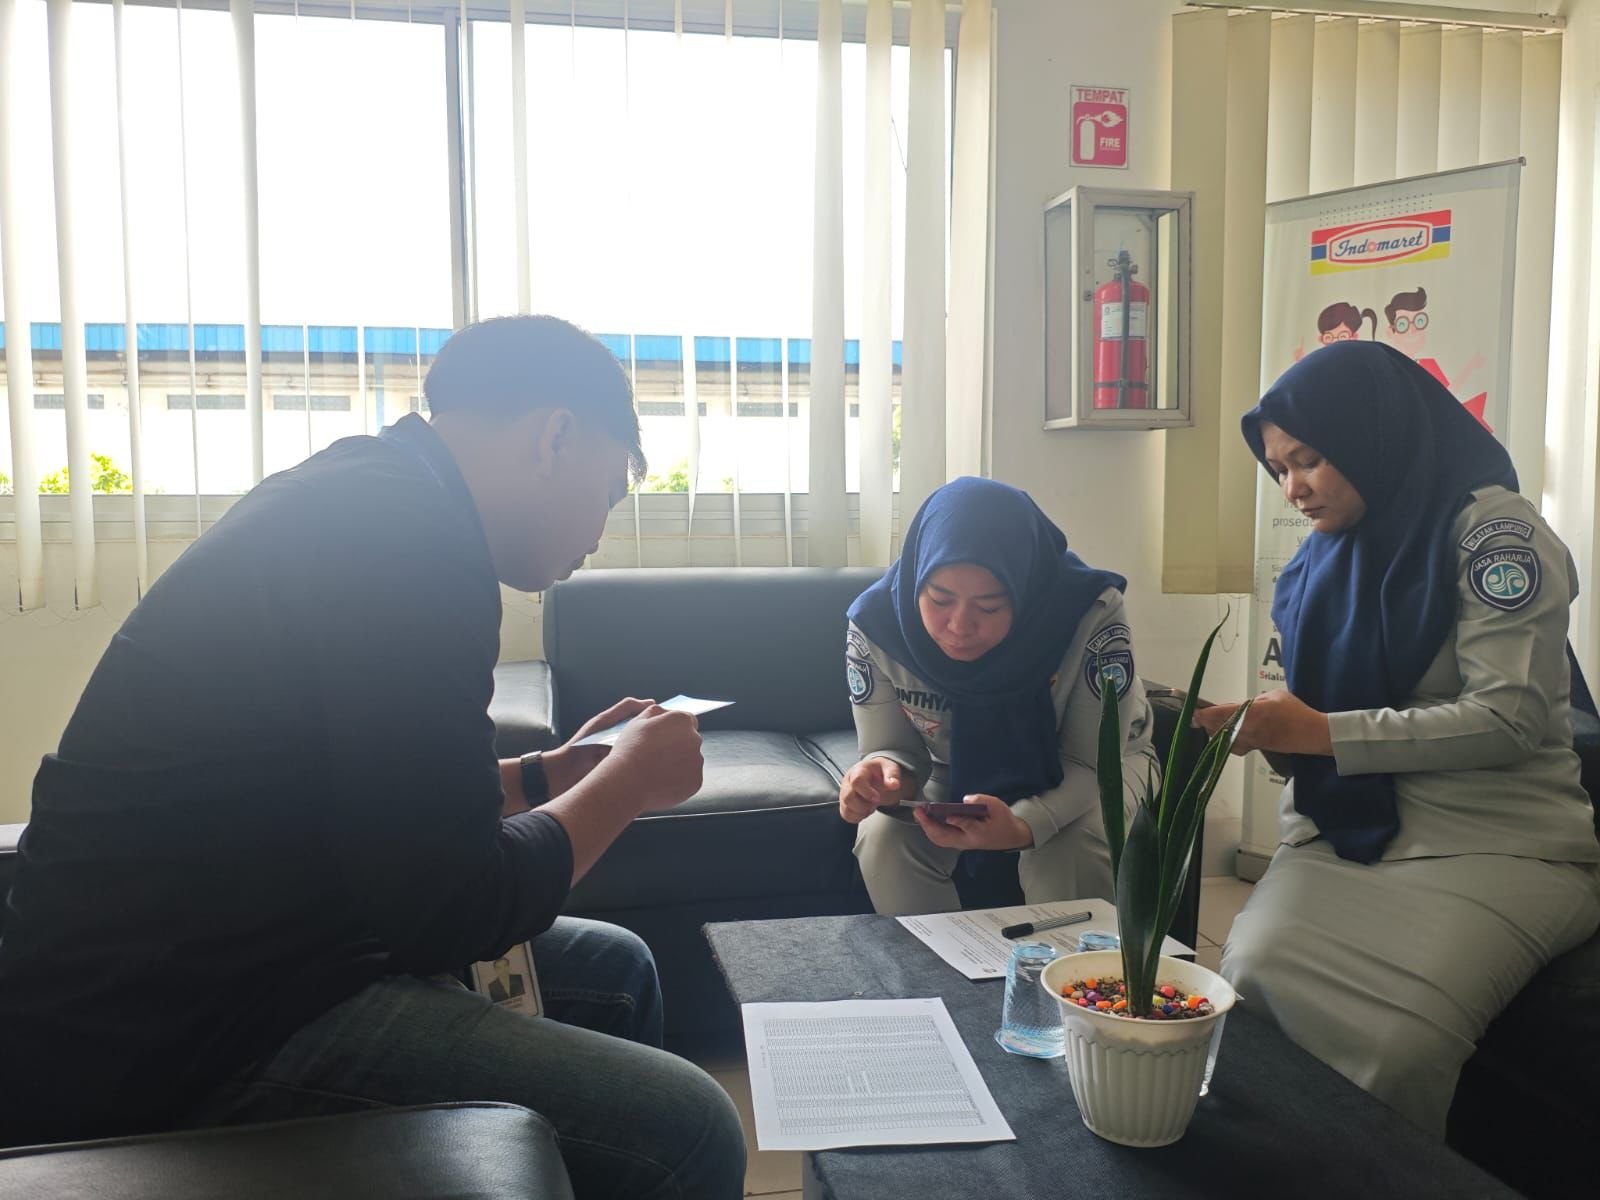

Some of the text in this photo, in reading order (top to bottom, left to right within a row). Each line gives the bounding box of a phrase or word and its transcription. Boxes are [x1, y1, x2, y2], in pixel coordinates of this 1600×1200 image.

[1076, 88, 1125, 102] TEMPAT
[1100, 137, 1120, 148] FIRE
[1335, 230, 1424, 257] Indomaret
[1474, 553, 1531, 571] JASA RAHARJA
